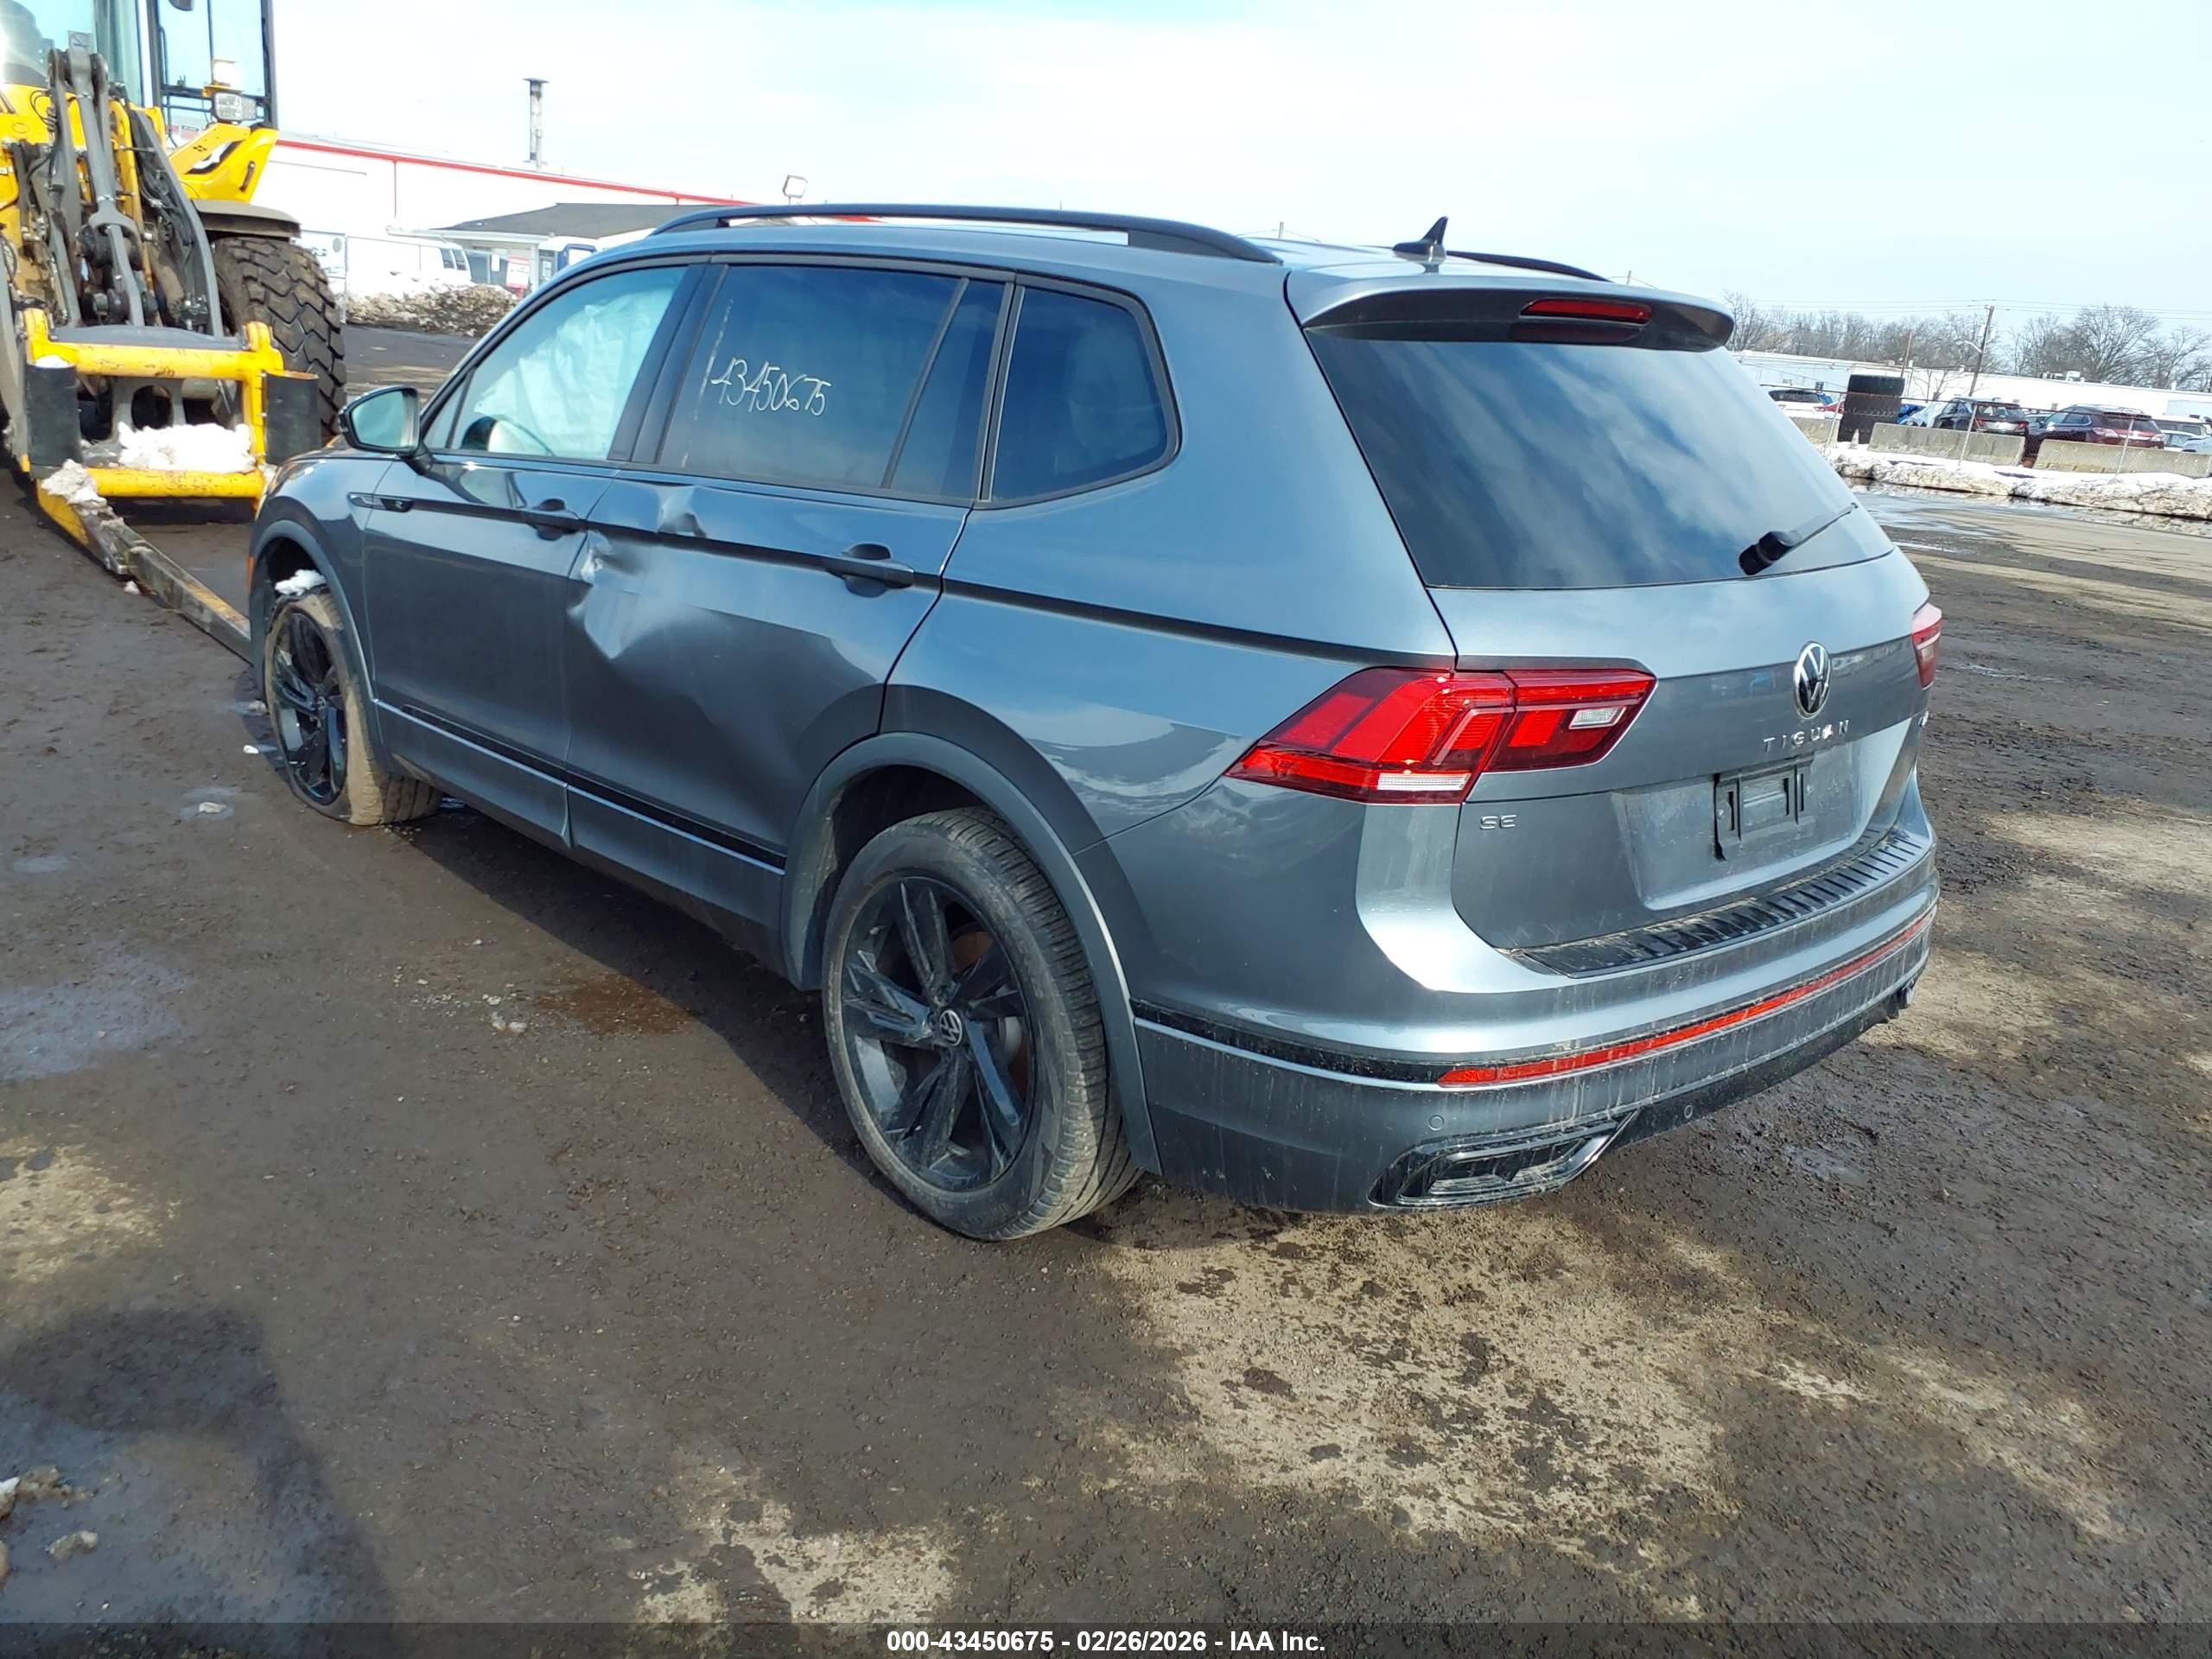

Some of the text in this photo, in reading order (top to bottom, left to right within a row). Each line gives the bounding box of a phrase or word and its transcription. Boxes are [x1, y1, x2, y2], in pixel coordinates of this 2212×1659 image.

[711, 358, 832, 416] 43450675
[1763, 720, 1850, 753] TIGUAN
[1480, 814, 1517, 830] SE
